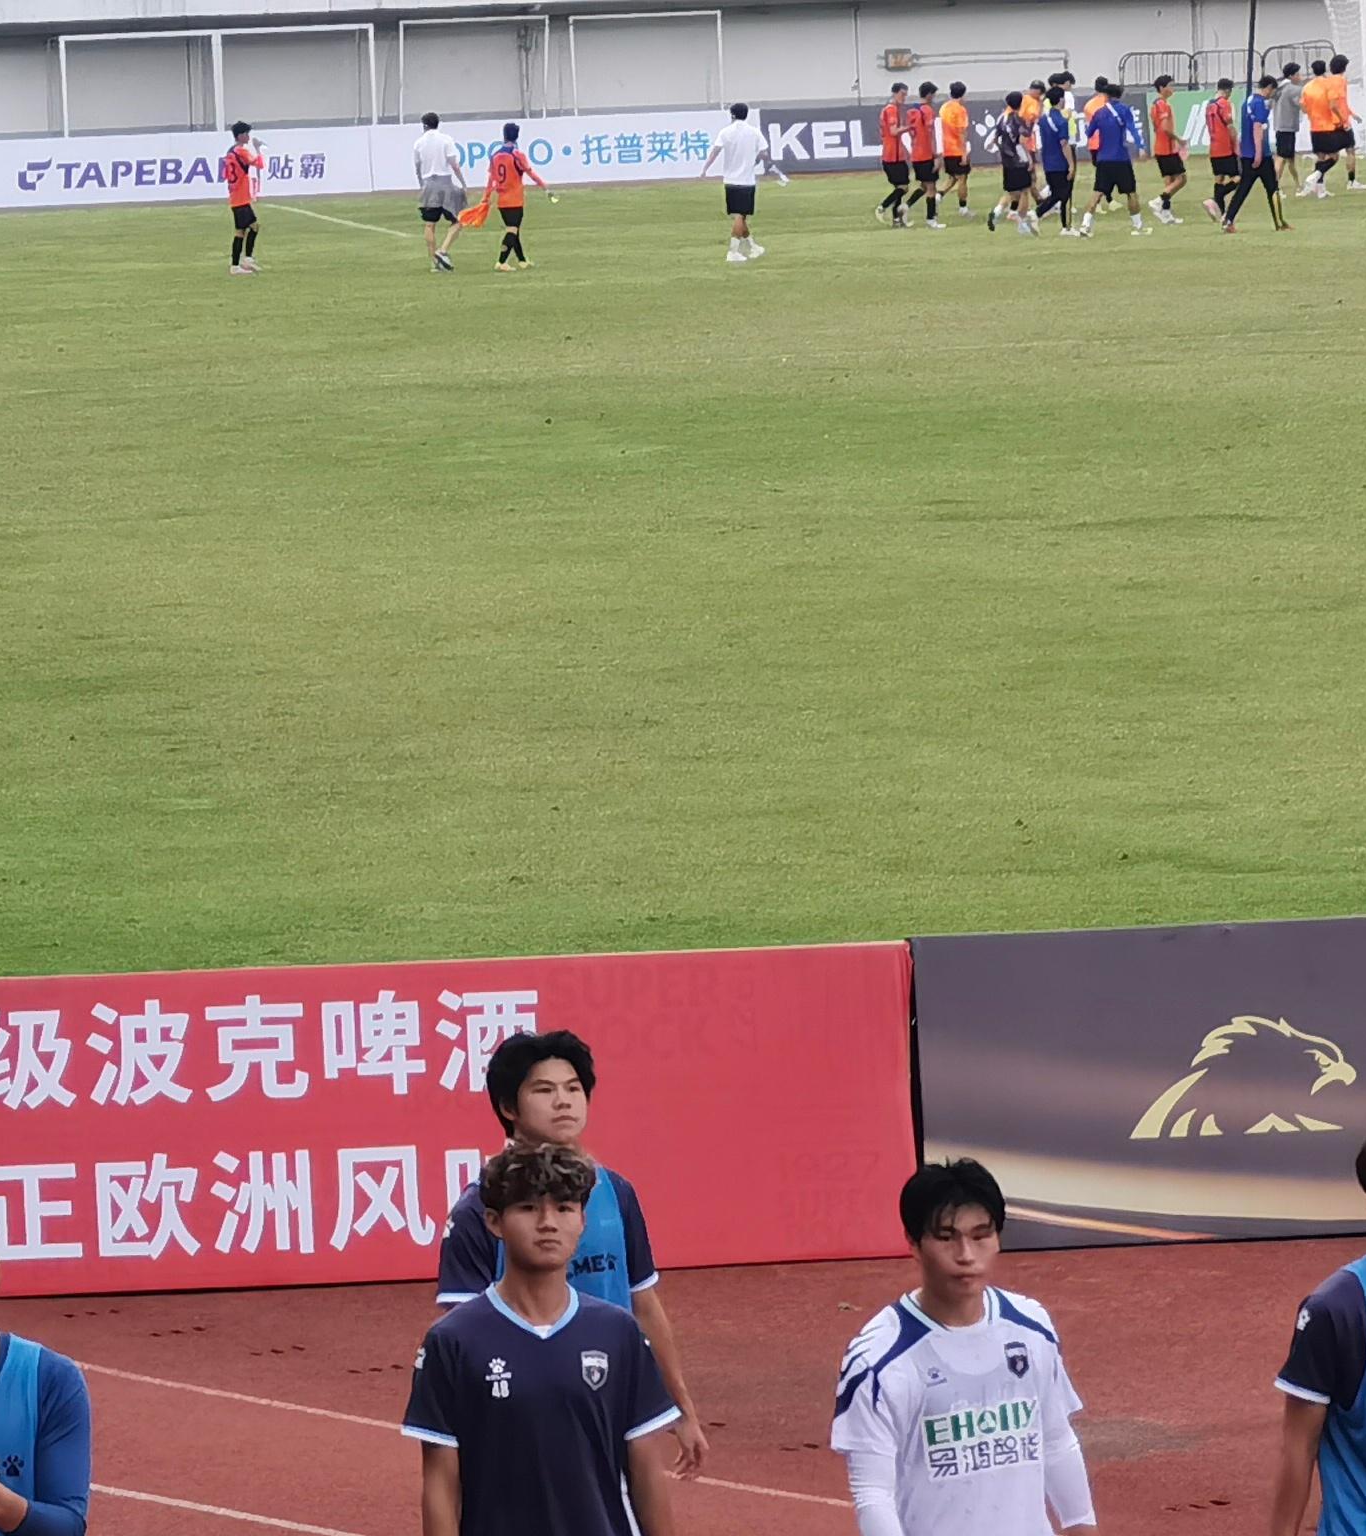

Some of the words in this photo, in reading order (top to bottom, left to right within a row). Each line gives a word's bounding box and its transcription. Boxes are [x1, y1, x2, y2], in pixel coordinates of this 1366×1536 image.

[580, 130, 711, 164] 托普莱特
[498, 163, 507, 184] 9
